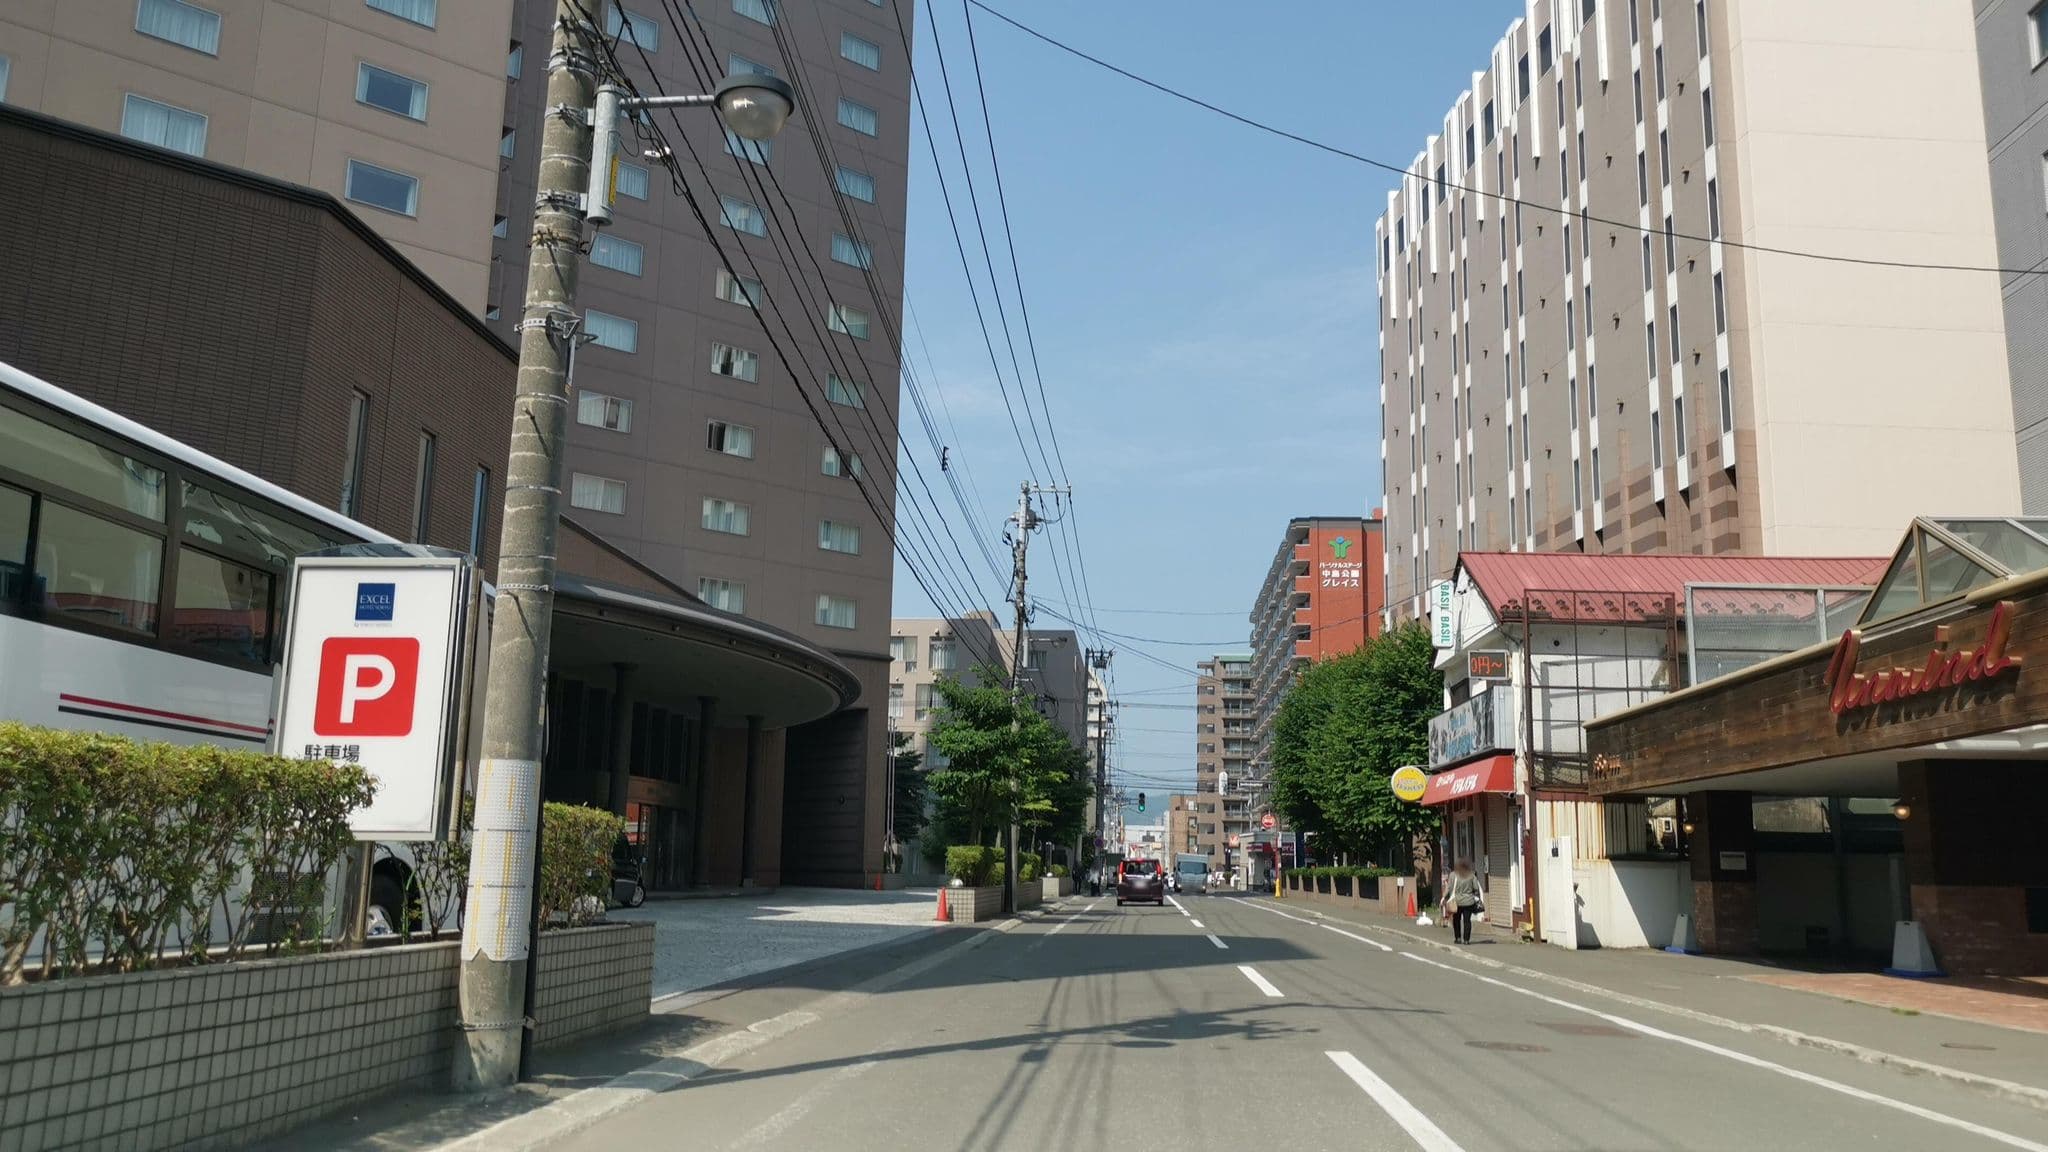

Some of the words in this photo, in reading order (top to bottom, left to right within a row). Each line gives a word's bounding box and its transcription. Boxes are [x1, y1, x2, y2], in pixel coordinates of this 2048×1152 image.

[1322, 579, 1359, 587] グレイス
[360, 594, 390, 604] EXCEL
[1440, 584, 1450, 610] BASIL
[1440, 616, 1450, 643] BASIL
[1823, 600, 2022, 714] Unwind
[340, 654, 396, 724] P
[304, 744, 360, 762] 駐車場
